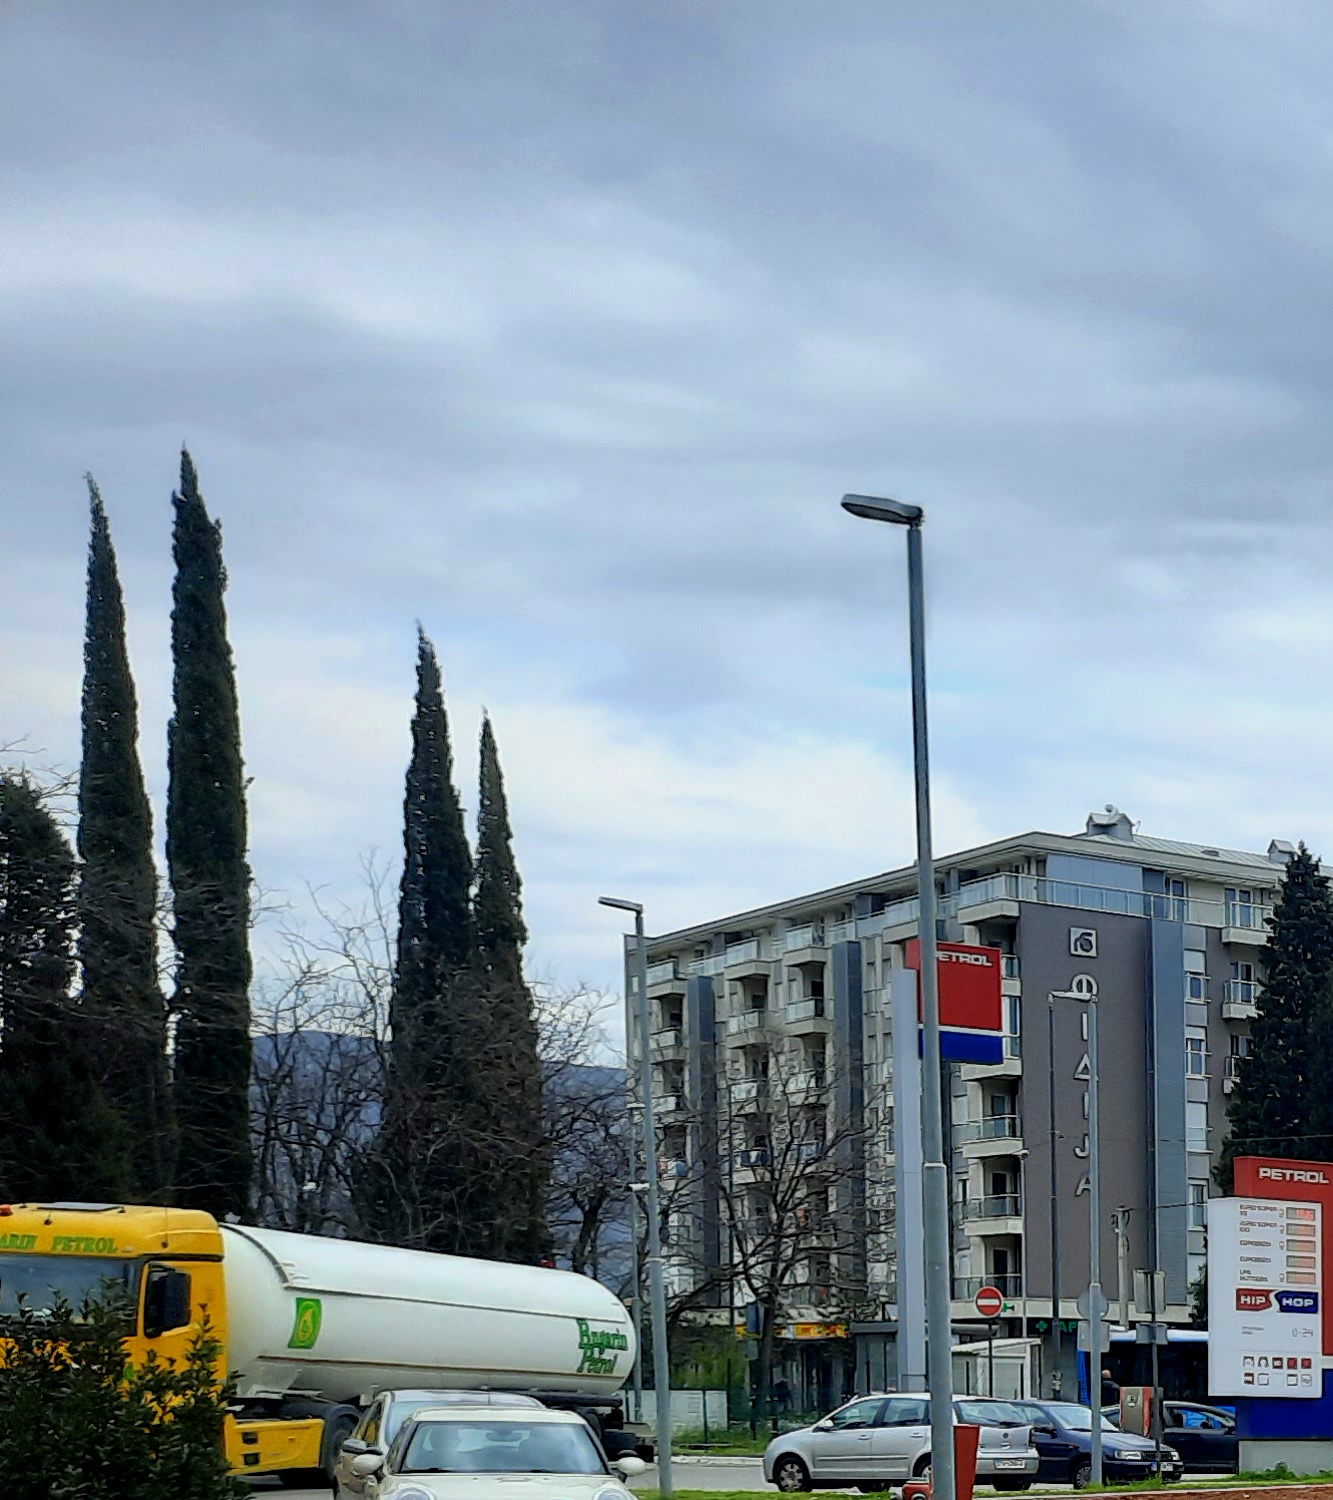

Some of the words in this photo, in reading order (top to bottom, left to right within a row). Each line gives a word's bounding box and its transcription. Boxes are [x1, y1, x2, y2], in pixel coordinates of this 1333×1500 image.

[937, 950, 993, 967] ETROL
[1258, 1167, 1330, 1184] PETROL
[51, 1235, 118, 1254] PETROL
[1240, 1295, 1266, 1305] HIP
[1282, 1297, 1314, 1308] HOP
